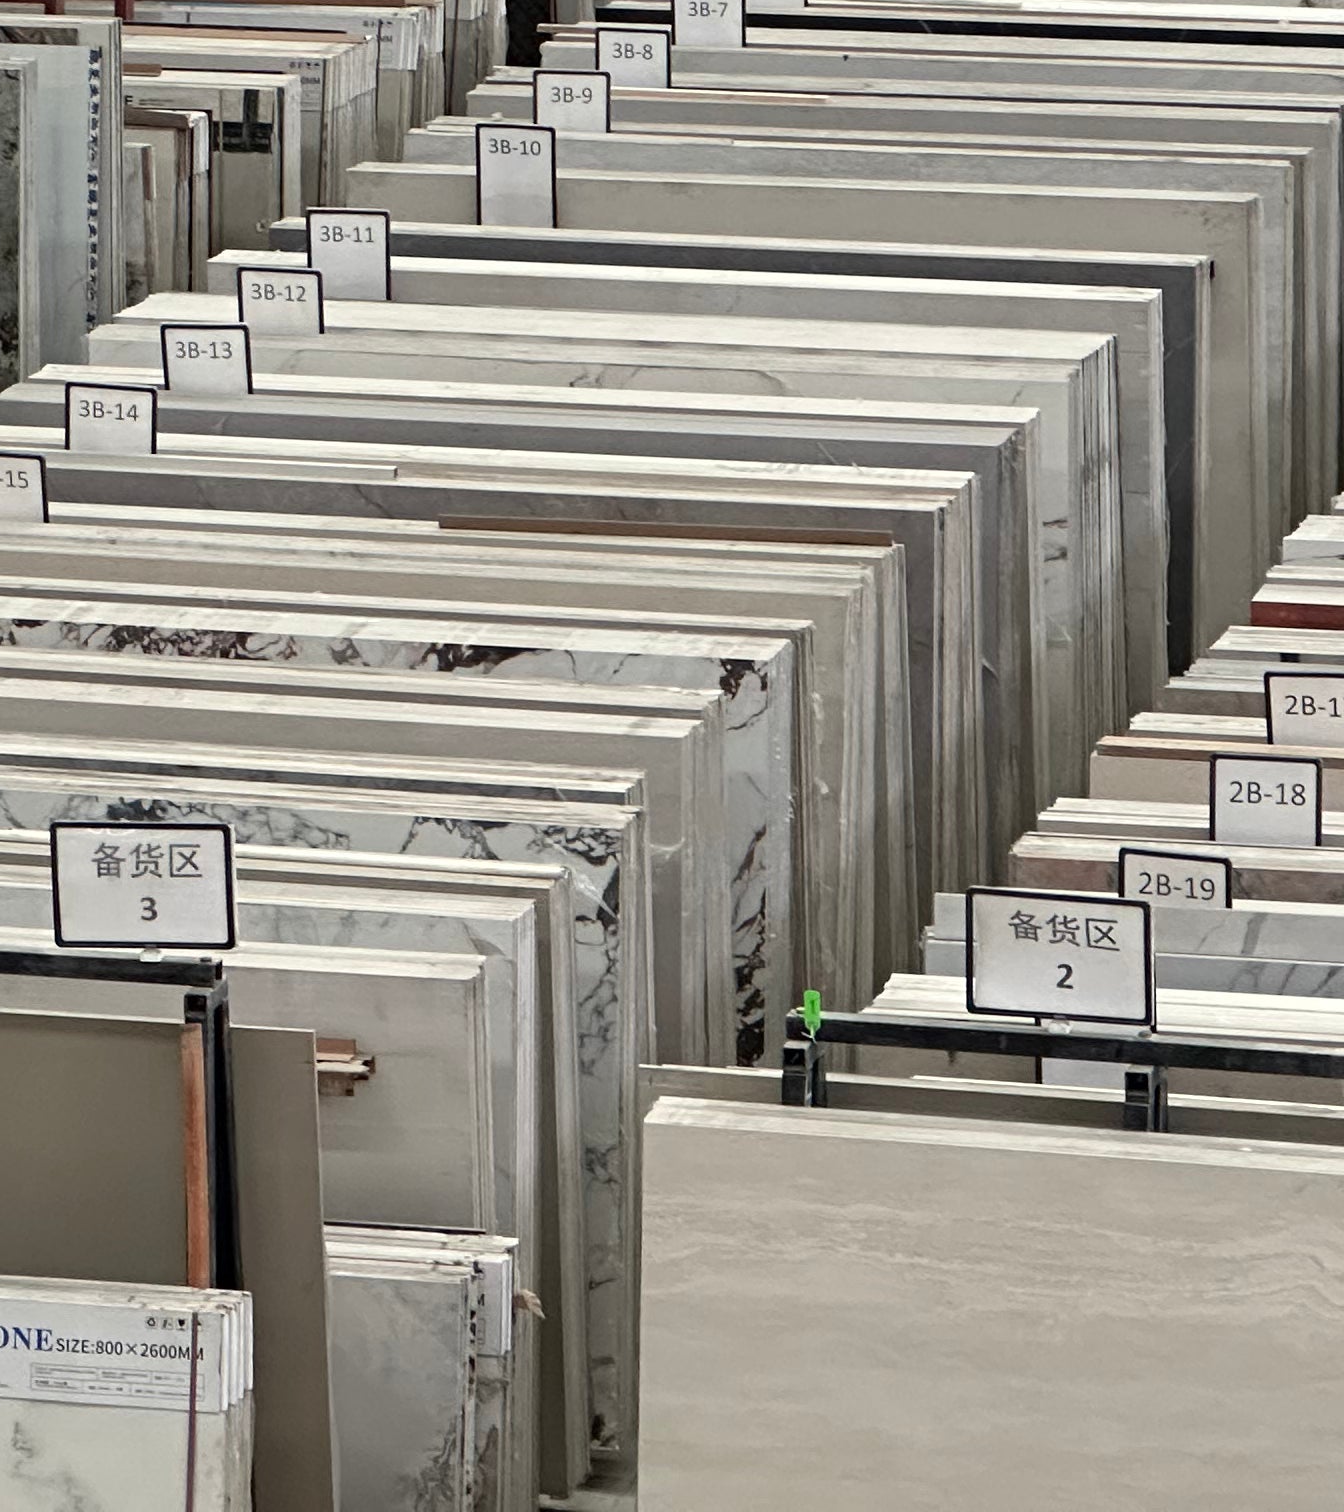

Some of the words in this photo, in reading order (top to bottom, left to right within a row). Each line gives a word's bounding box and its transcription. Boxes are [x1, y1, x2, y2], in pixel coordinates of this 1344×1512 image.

[689, 2, 727, 17] 3B-7
[613, 43, 653, 60] 3B-8
[552, 87, 592, 104] 3B-9
[489, 138, 541, 155] 3B-10
[320, 226, 374, 243] 3B-11
[252, 284, 306, 302] 3B-12
[176, 341, 232, 359] 3B-13
[79, 400, 138, 421] 3B-14
[1230, 781, 1305, 806] 2B-18
[92, 843, 202, 878] 备货区
[1139, 872, 1215, 900] 2B-19
[141, 897, 157, 921] 3
[1008, 910, 1120, 951] 备货区
[1057, 964, 1073, 989] 2
